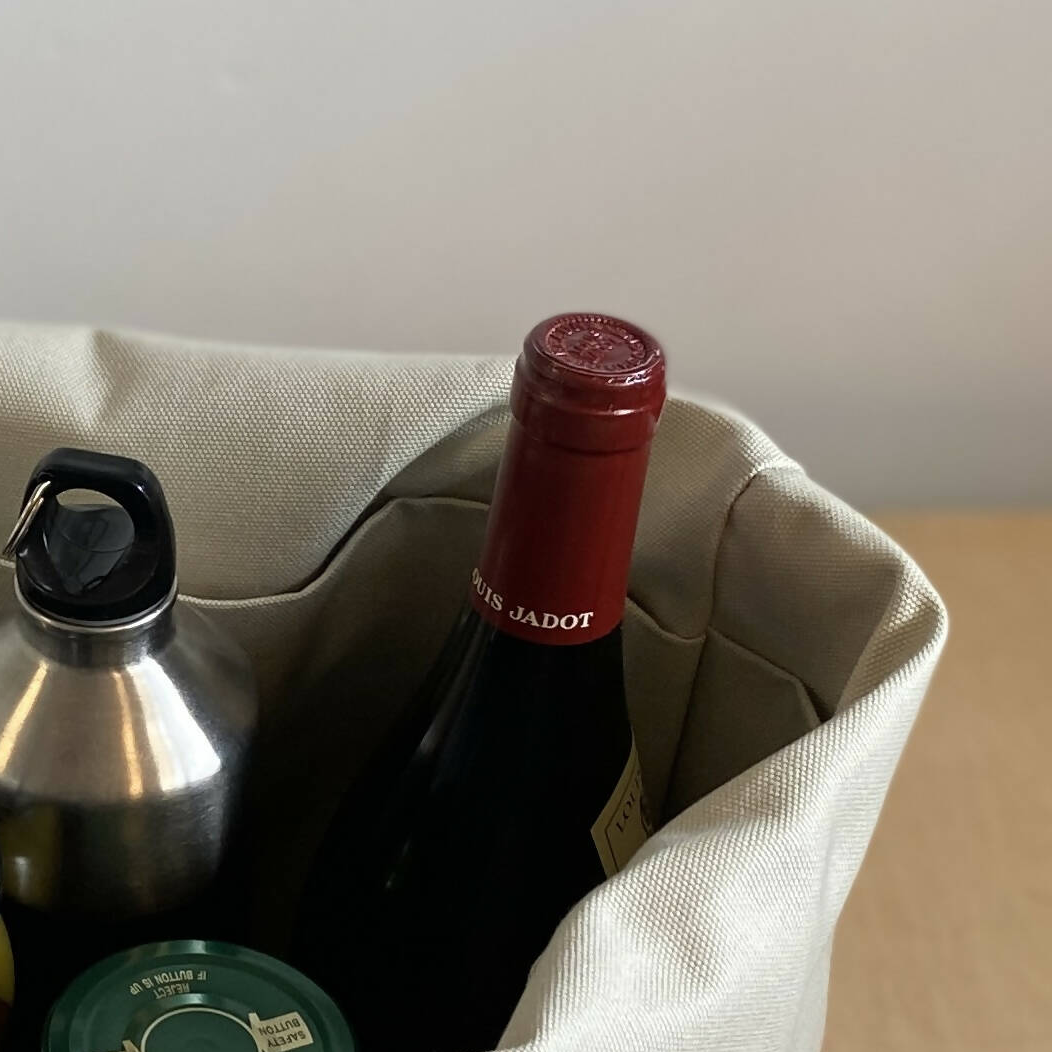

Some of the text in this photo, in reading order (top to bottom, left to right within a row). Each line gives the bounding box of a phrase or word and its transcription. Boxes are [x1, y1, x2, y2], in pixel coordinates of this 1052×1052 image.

[509, 605, 595, 630] JADOT
[129, 969, 207, 996] IF BUTTON IS UP
[153, 983, 190, 1000] REJECT
[258, 1017, 301, 1036] BUTTON
[267, 1030, 306, 1048] SAFETY
